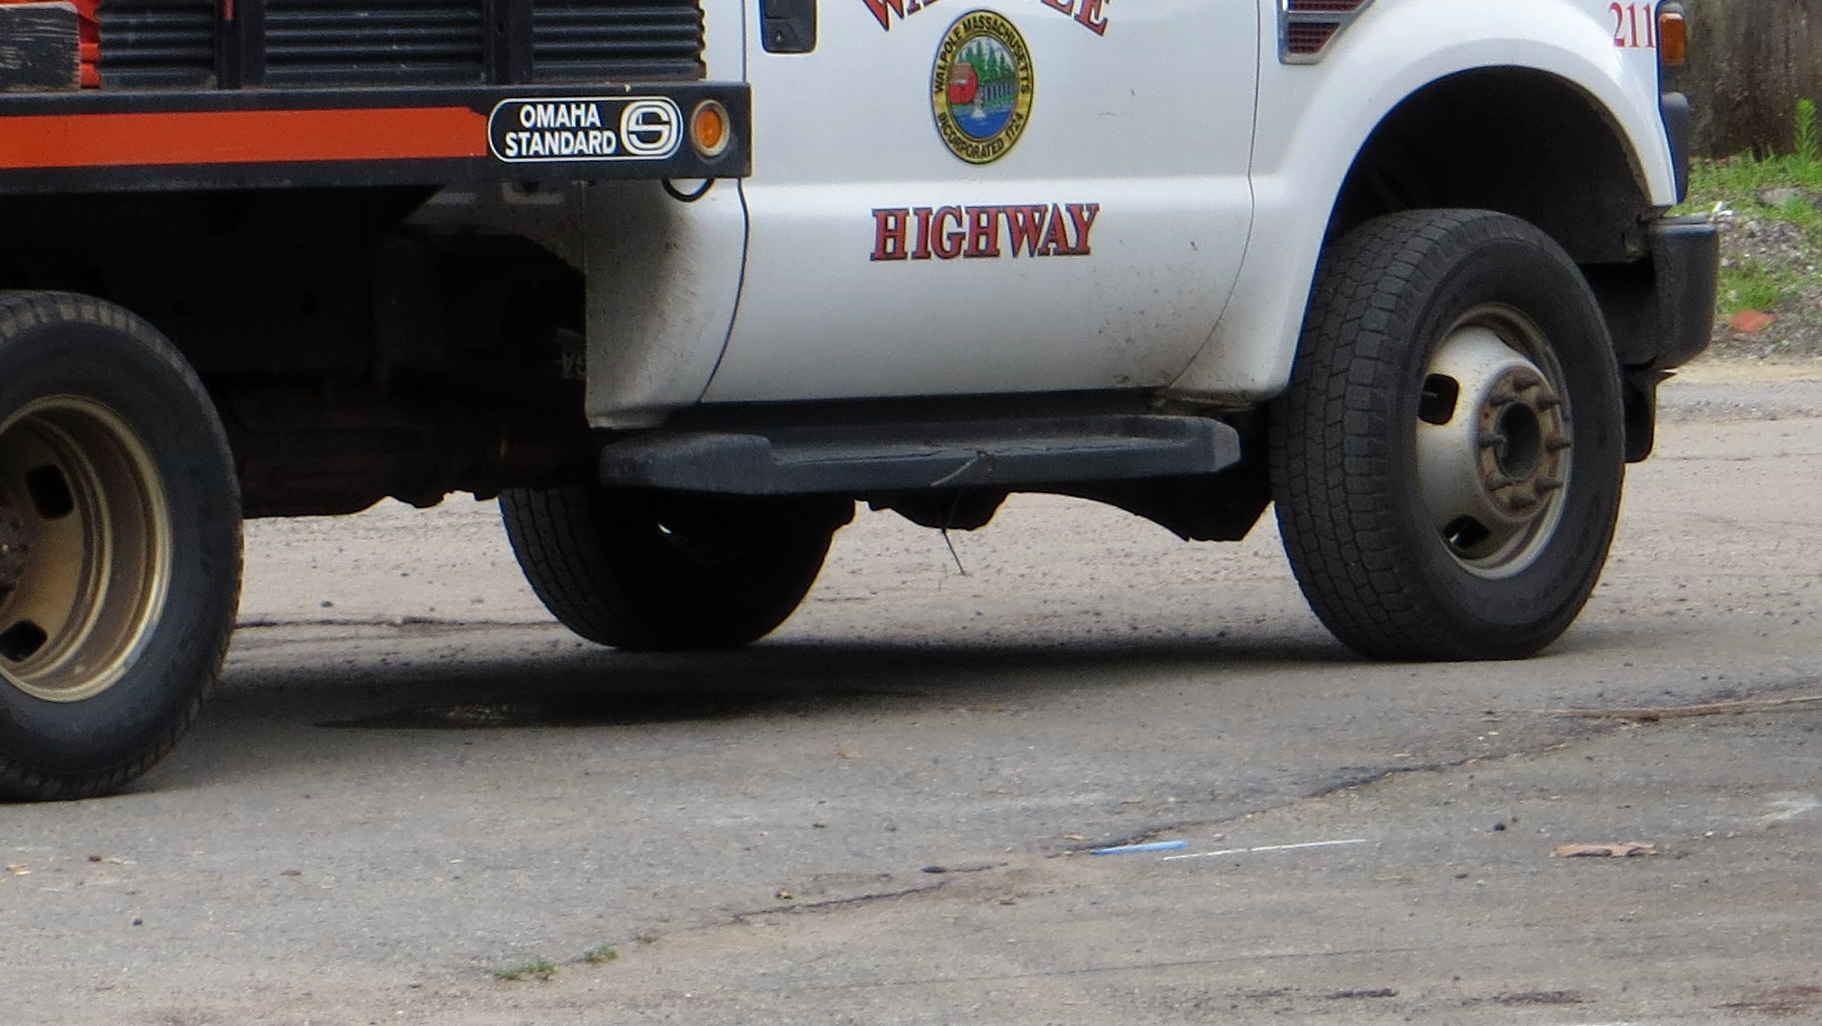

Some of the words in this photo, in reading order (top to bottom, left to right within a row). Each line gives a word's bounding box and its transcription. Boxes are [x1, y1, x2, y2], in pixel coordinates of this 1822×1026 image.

[1609, 2, 1655, 48] 211
[934, 26, 963, 94] WALPOLE
[961, 15, 1031, 94] MASSACHUSETTS
[519, 103, 601, 127] OMAHA
[938, 112, 1004, 158] INCORPORATED
[505, 130, 617, 156] STANDARD
[870, 203, 1100, 262] HIGHWAY
